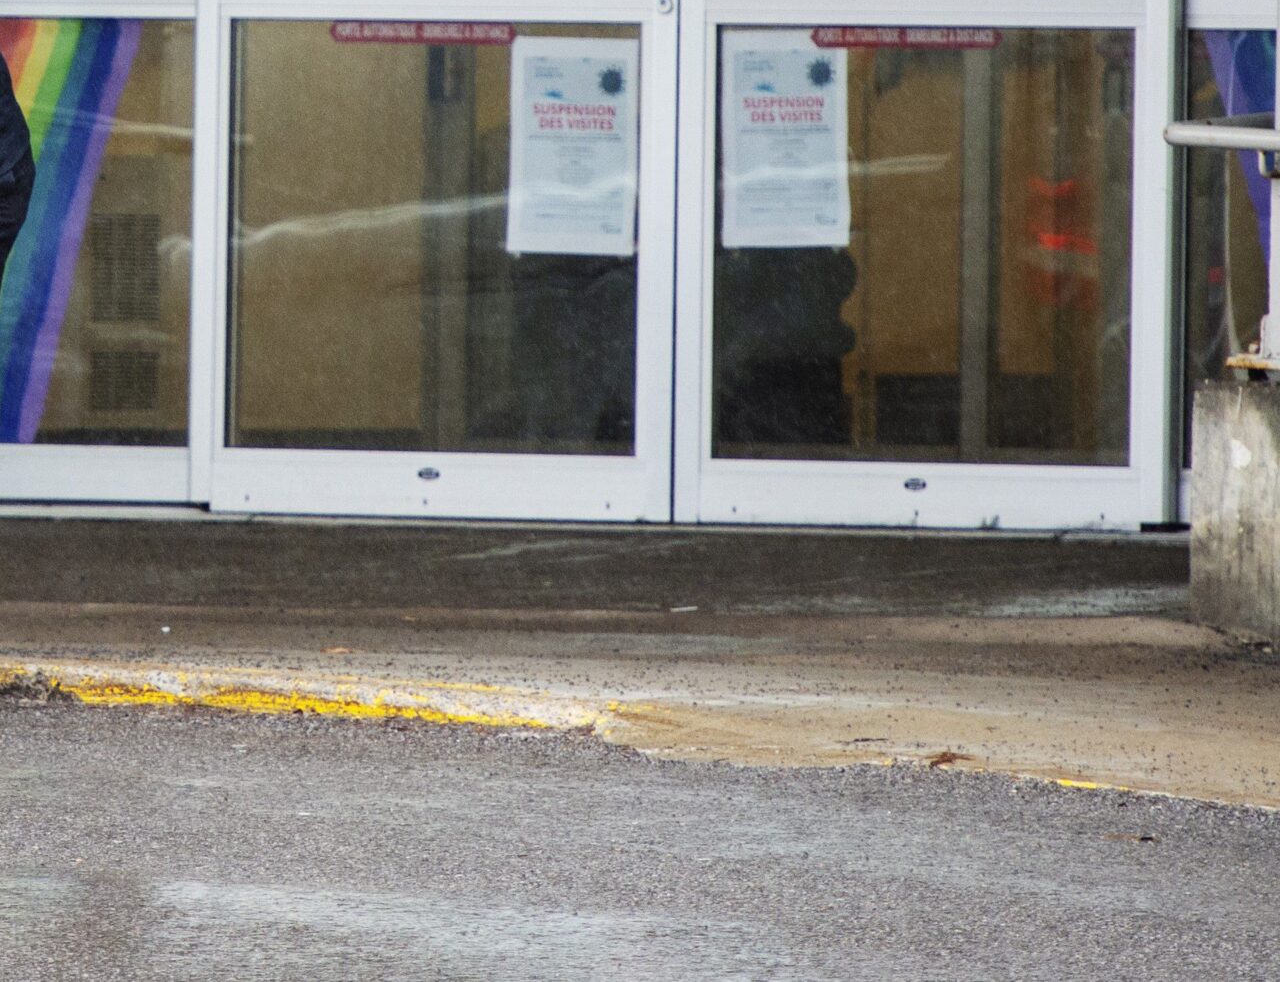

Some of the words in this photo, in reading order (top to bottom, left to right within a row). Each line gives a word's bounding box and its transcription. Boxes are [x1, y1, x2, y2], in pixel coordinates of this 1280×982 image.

[743, 97, 825, 109] SUSPENSION
[533, 103, 616, 116] SUSPENSION
[750, 111, 775, 123] DES
[779, 110, 823, 122] VISITES
[539, 118, 563, 130] DES
[567, 119, 614, 130] VISITES
